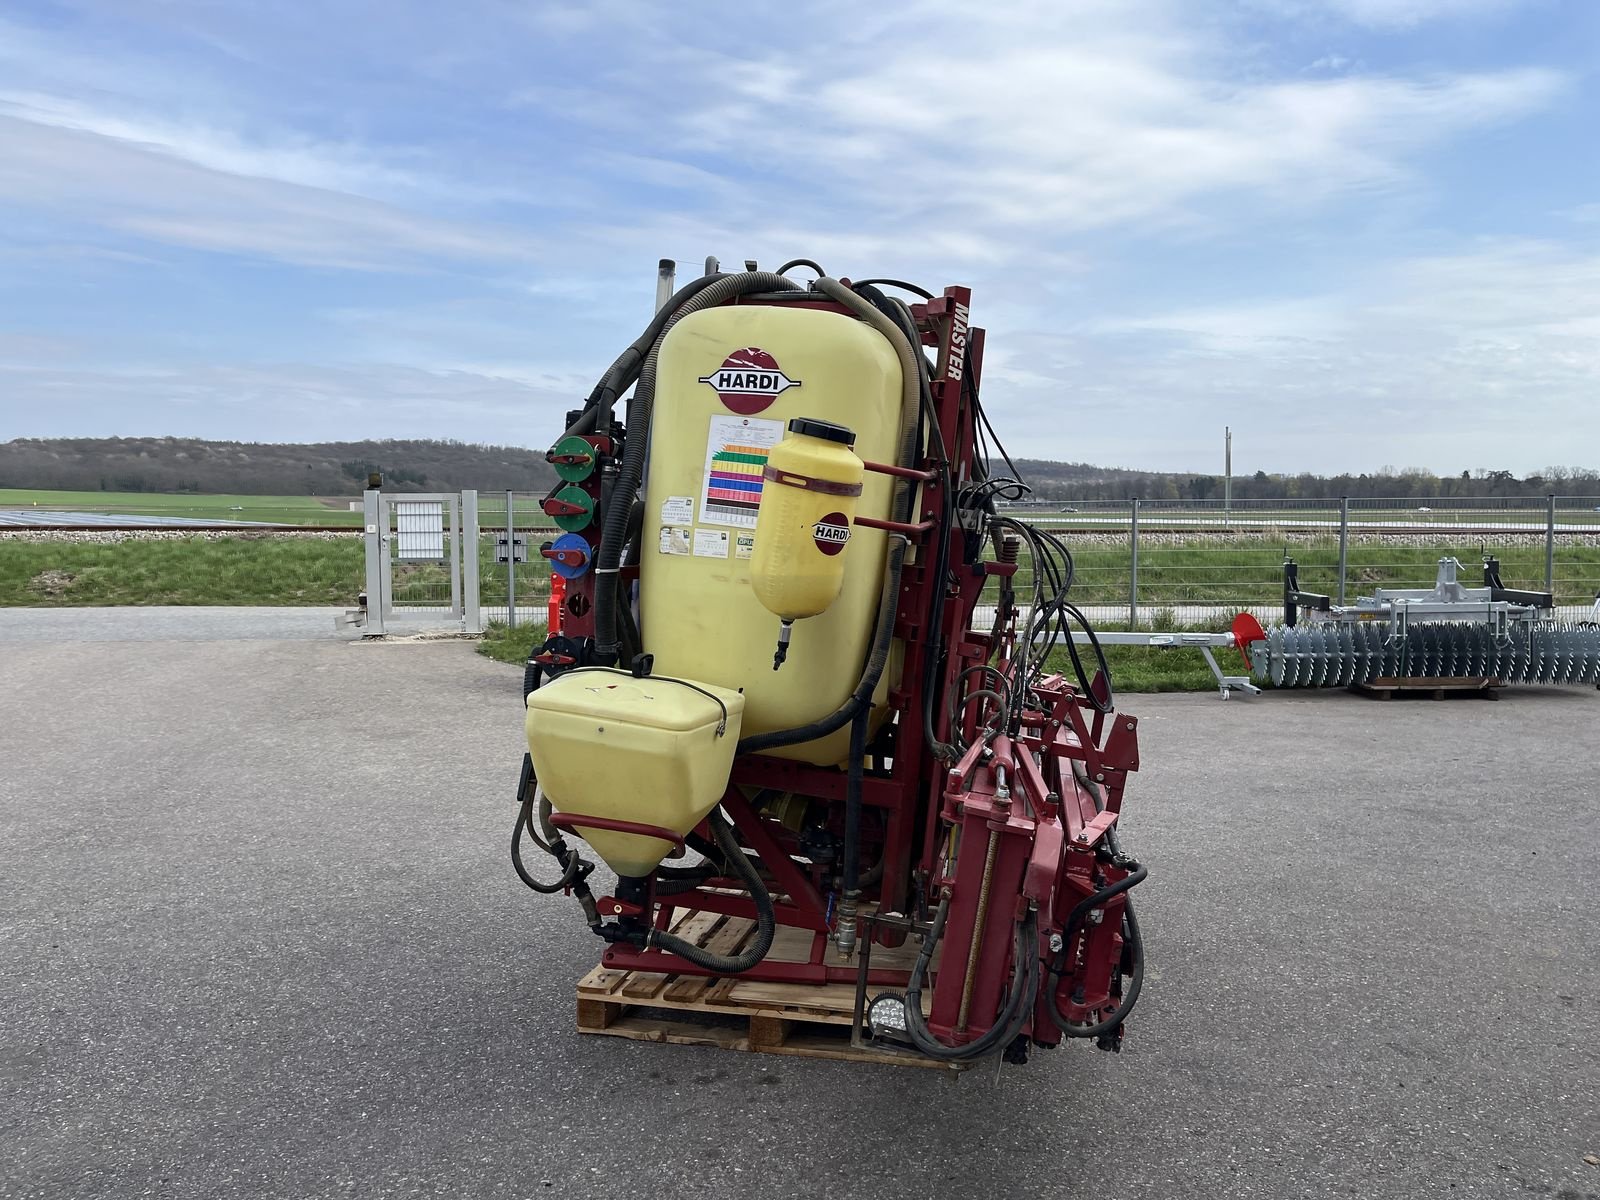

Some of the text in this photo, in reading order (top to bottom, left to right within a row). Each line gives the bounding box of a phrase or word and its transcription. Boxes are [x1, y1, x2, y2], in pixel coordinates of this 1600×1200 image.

[948, 302, 968, 380] MASTER
[718, 373, 779, 390] HARDI
[815, 526, 848, 540] HARDI
